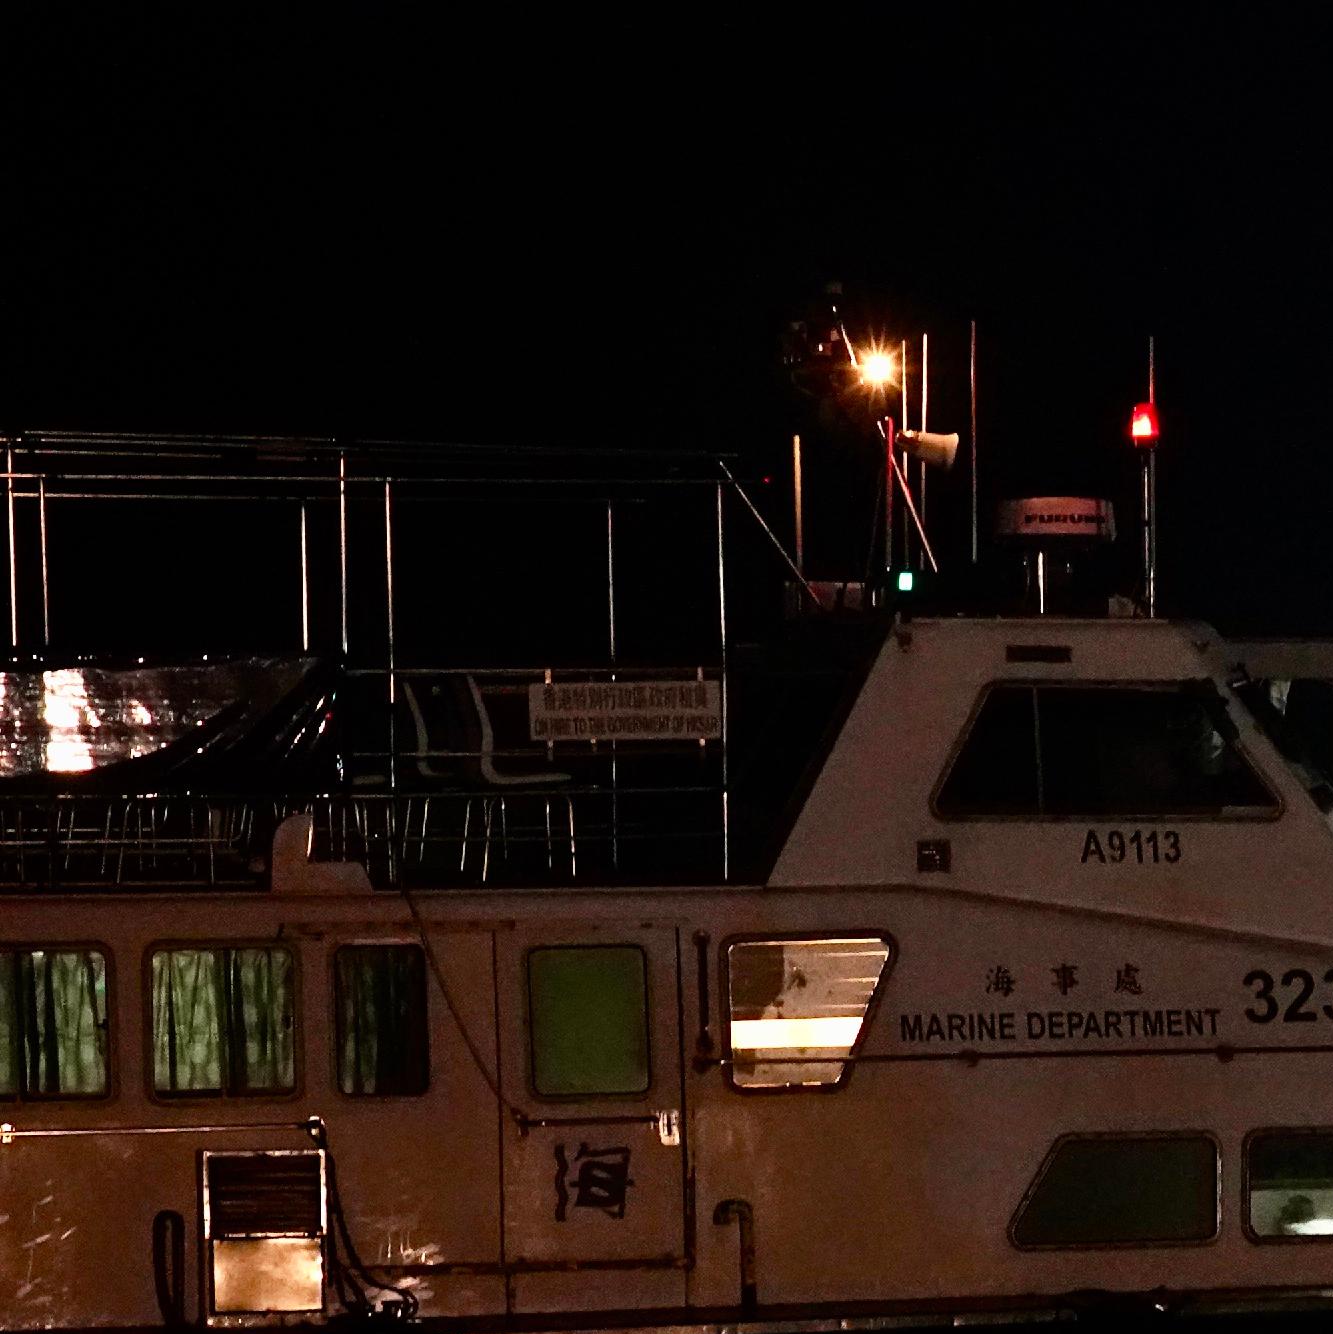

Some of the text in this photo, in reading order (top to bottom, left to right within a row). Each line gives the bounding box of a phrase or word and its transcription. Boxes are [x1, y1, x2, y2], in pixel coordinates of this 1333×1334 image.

[1081, 829, 1181, 863] A9113
[986, 963, 1144, 997] 海事處
[900, 1009, 1221, 1042] MARINE DEPARTMENT
